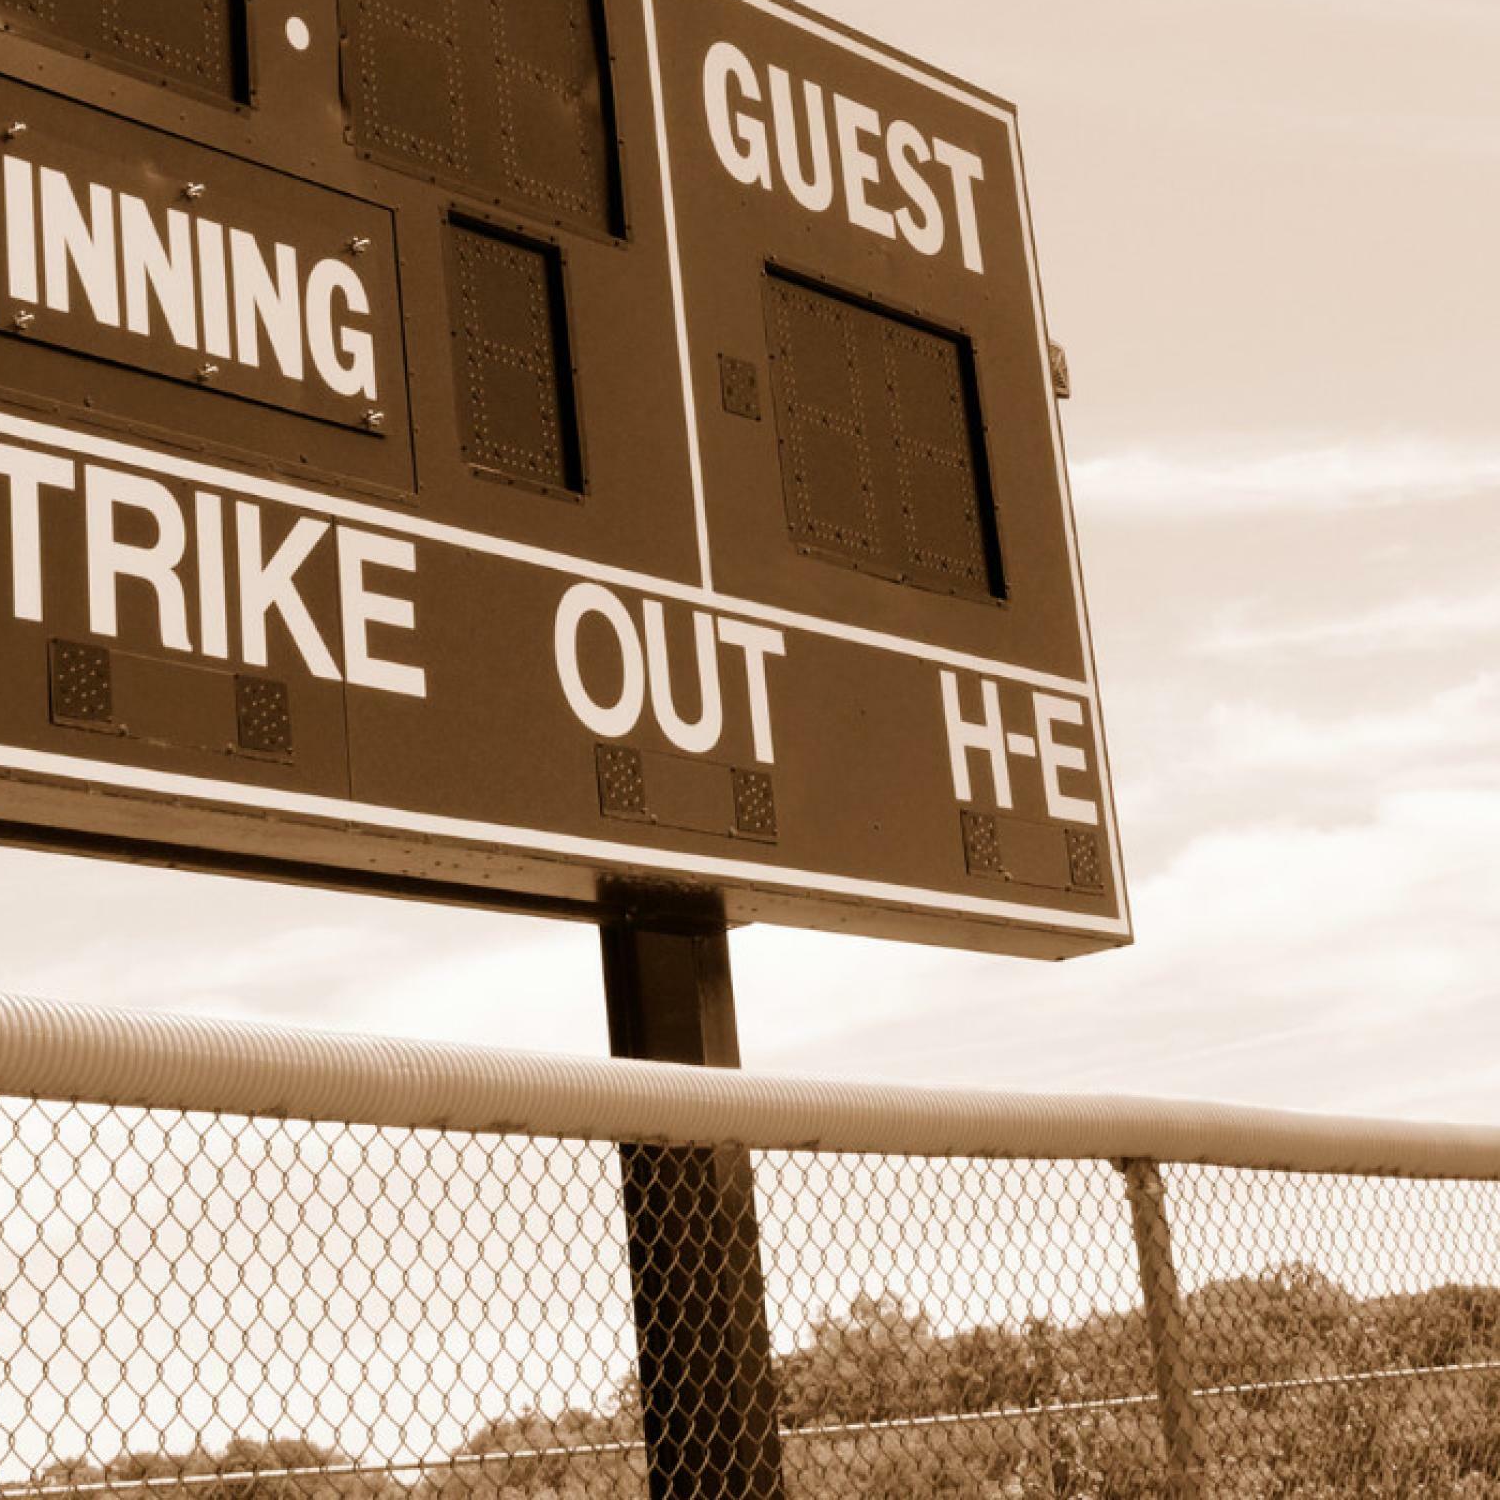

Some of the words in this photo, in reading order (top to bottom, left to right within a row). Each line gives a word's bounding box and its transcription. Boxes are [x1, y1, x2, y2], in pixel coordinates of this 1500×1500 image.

[703, 42, 984, 275] GUEST
[3, 155, 377, 401] INNING
[554, 582, 786, 764] OUT
[940, 670, 1098, 826] H-E
